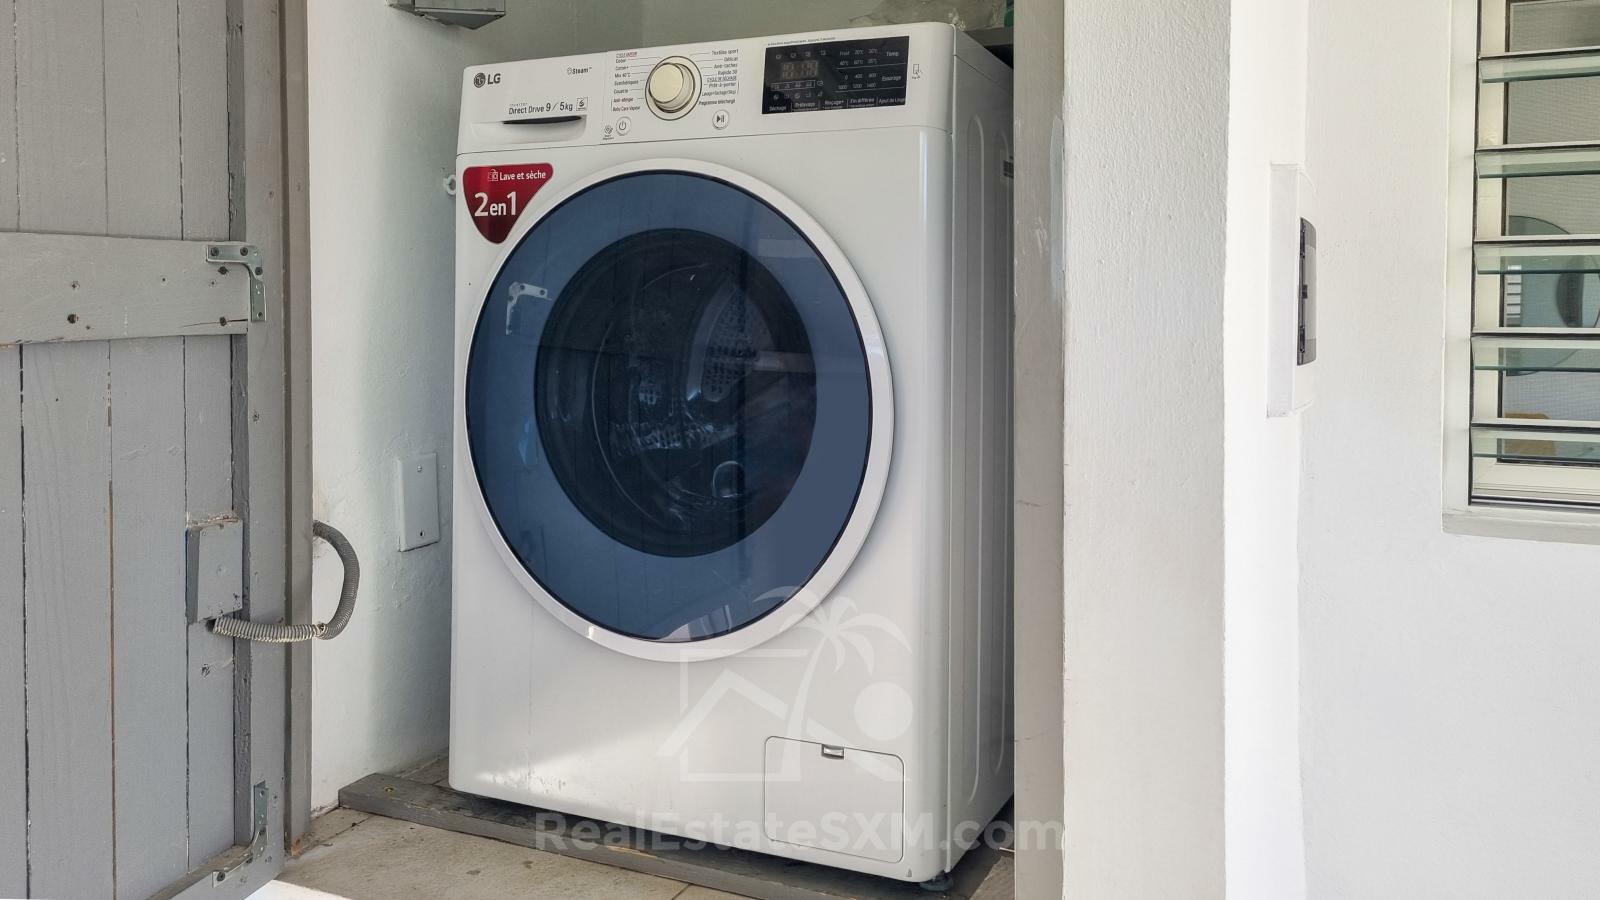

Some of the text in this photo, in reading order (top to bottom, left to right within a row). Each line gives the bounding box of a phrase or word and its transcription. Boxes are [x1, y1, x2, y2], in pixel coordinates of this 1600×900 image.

[487, 74, 501, 85] LG
[508, 107, 527, 115] Direct
[528, 105, 545, 113] Drive
[500, 172, 515, 181] Lave
[526, 170, 546, 179] sèche
